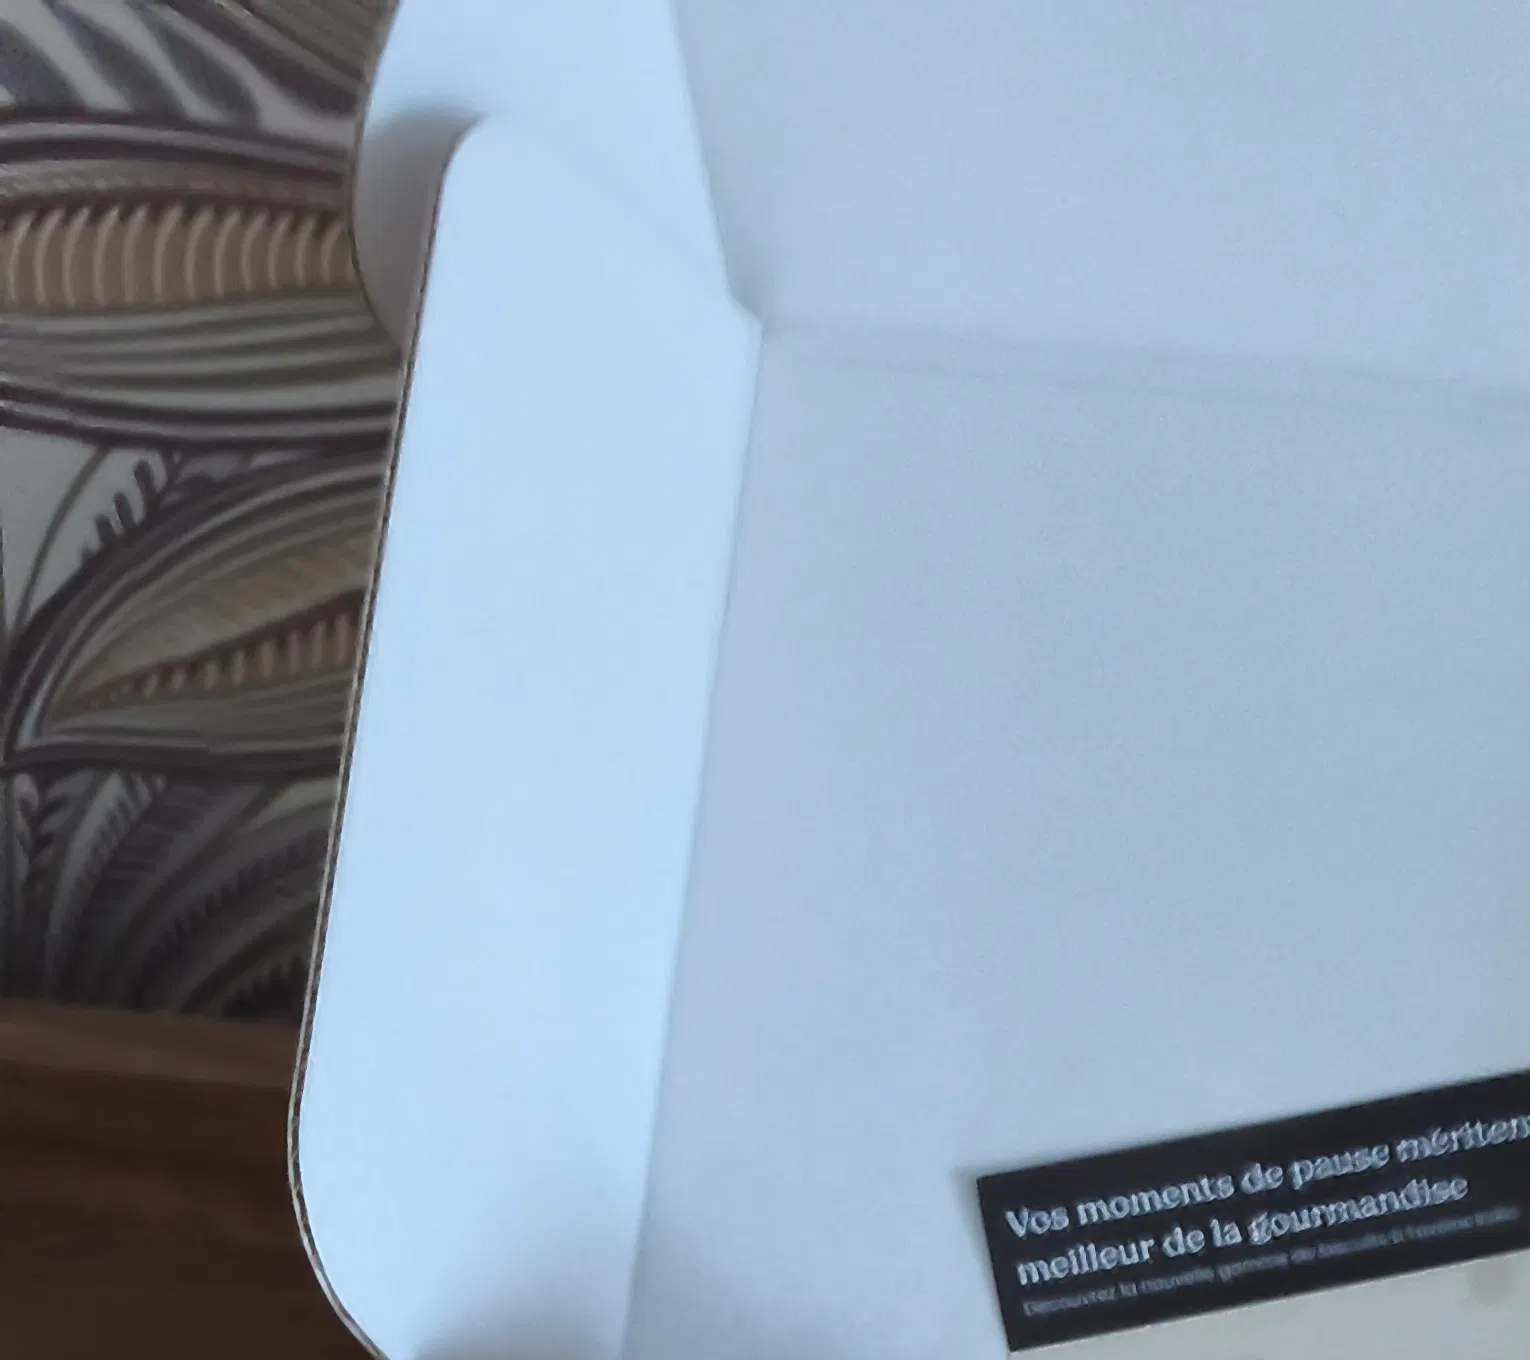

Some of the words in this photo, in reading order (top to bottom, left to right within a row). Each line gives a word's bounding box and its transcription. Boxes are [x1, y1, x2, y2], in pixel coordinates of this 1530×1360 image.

[1004, 1206, 1070, 1238] Vos
[1076, 1174, 1235, 1226] moments
[1240, 1162, 1284, 1195] de
[1288, 1144, 1390, 1190] pause
[1016, 1242, 1155, 1286] meilleur
[1162, 1226, 1205, 1258] de
[1209, 1218, 1242, 1248] la
[1248, 1177, 1469, 1246] gourmandise
